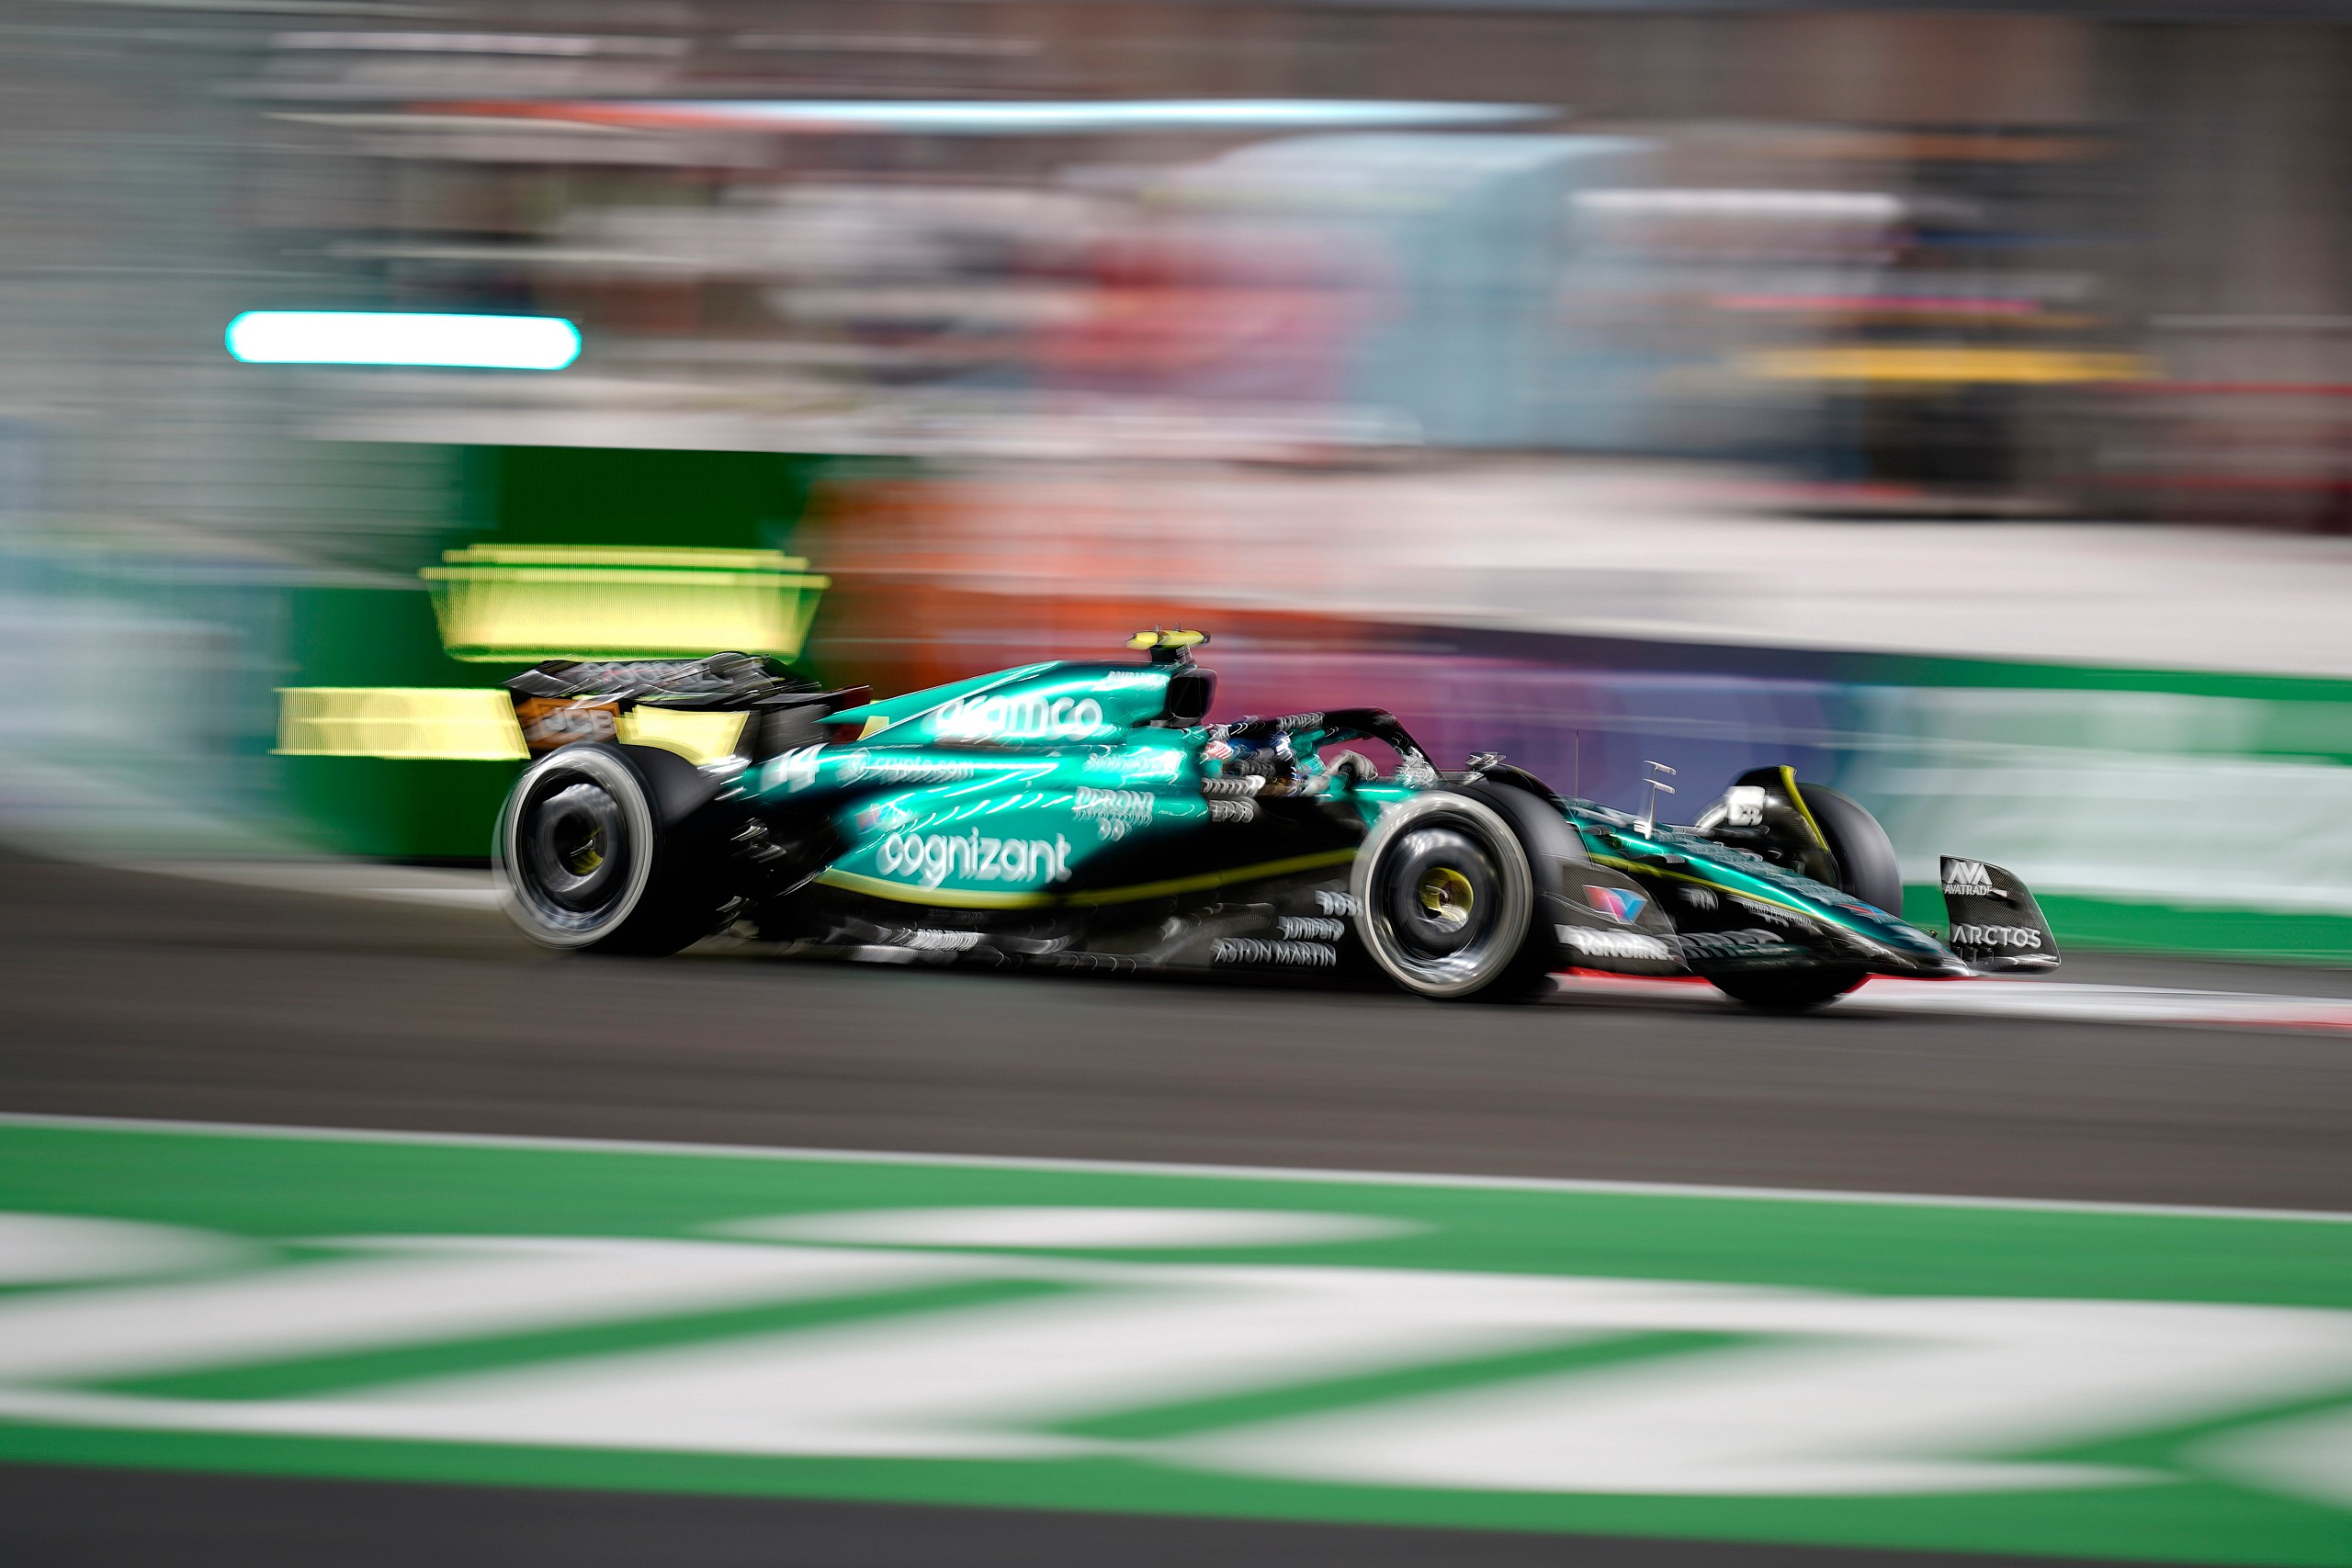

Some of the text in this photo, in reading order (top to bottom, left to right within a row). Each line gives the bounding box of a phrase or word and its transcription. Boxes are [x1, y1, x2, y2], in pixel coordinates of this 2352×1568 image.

[538, 706, 616, 736] JCB
[924, 694, 1103, 740] aramco
[880, 827, 1072, 891] cognizant
[1944, 883, 1992, 896] AVATRADE
[1950, 924, 2042, 949] ARCTOS
[1210, 937, 1337, 967] ASTON MARTIN
